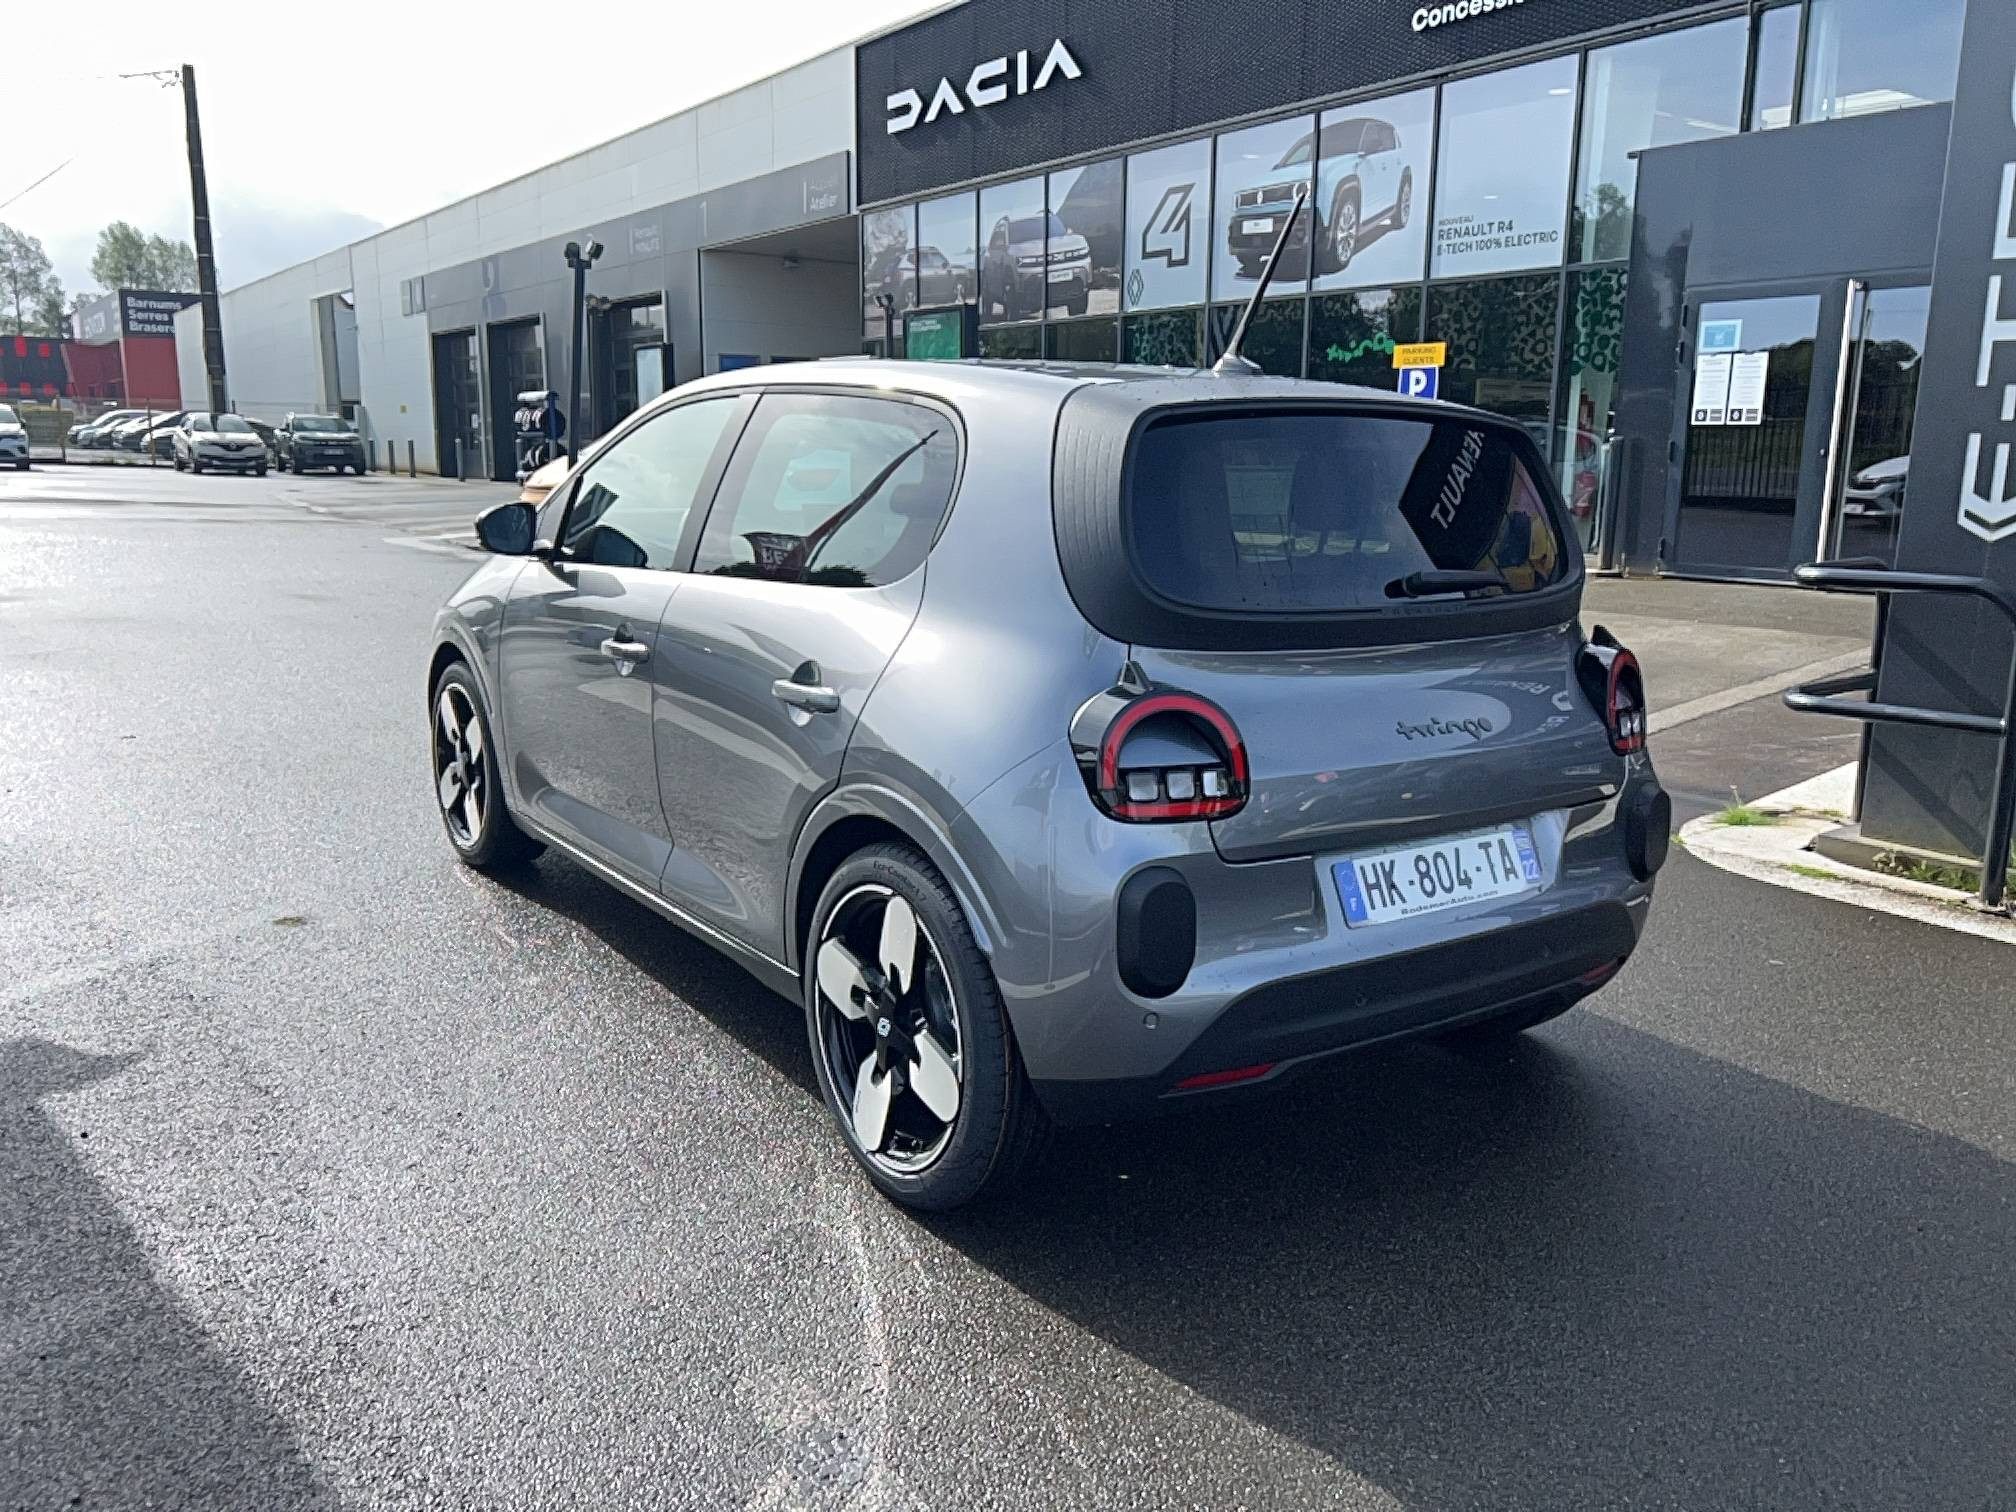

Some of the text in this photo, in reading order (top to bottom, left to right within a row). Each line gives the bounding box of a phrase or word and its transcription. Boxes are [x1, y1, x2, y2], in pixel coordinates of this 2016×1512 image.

[1411, 0, 1525, 32] Concess
[886, 38, 1082, 135] DACIA
[1141, 182, 1197, 268] 4
[1438, 220, 1514, 241] RENAULT R4
[1436, 230, 1559, 256] E-TECH 100% ELECTRIC
[127, 296, 182, 310] Barnums
[128, 308, 169, 321] Serres
[1402, 346, 1437, 356] PARKING
[1408, 369, 1428, 398] P
